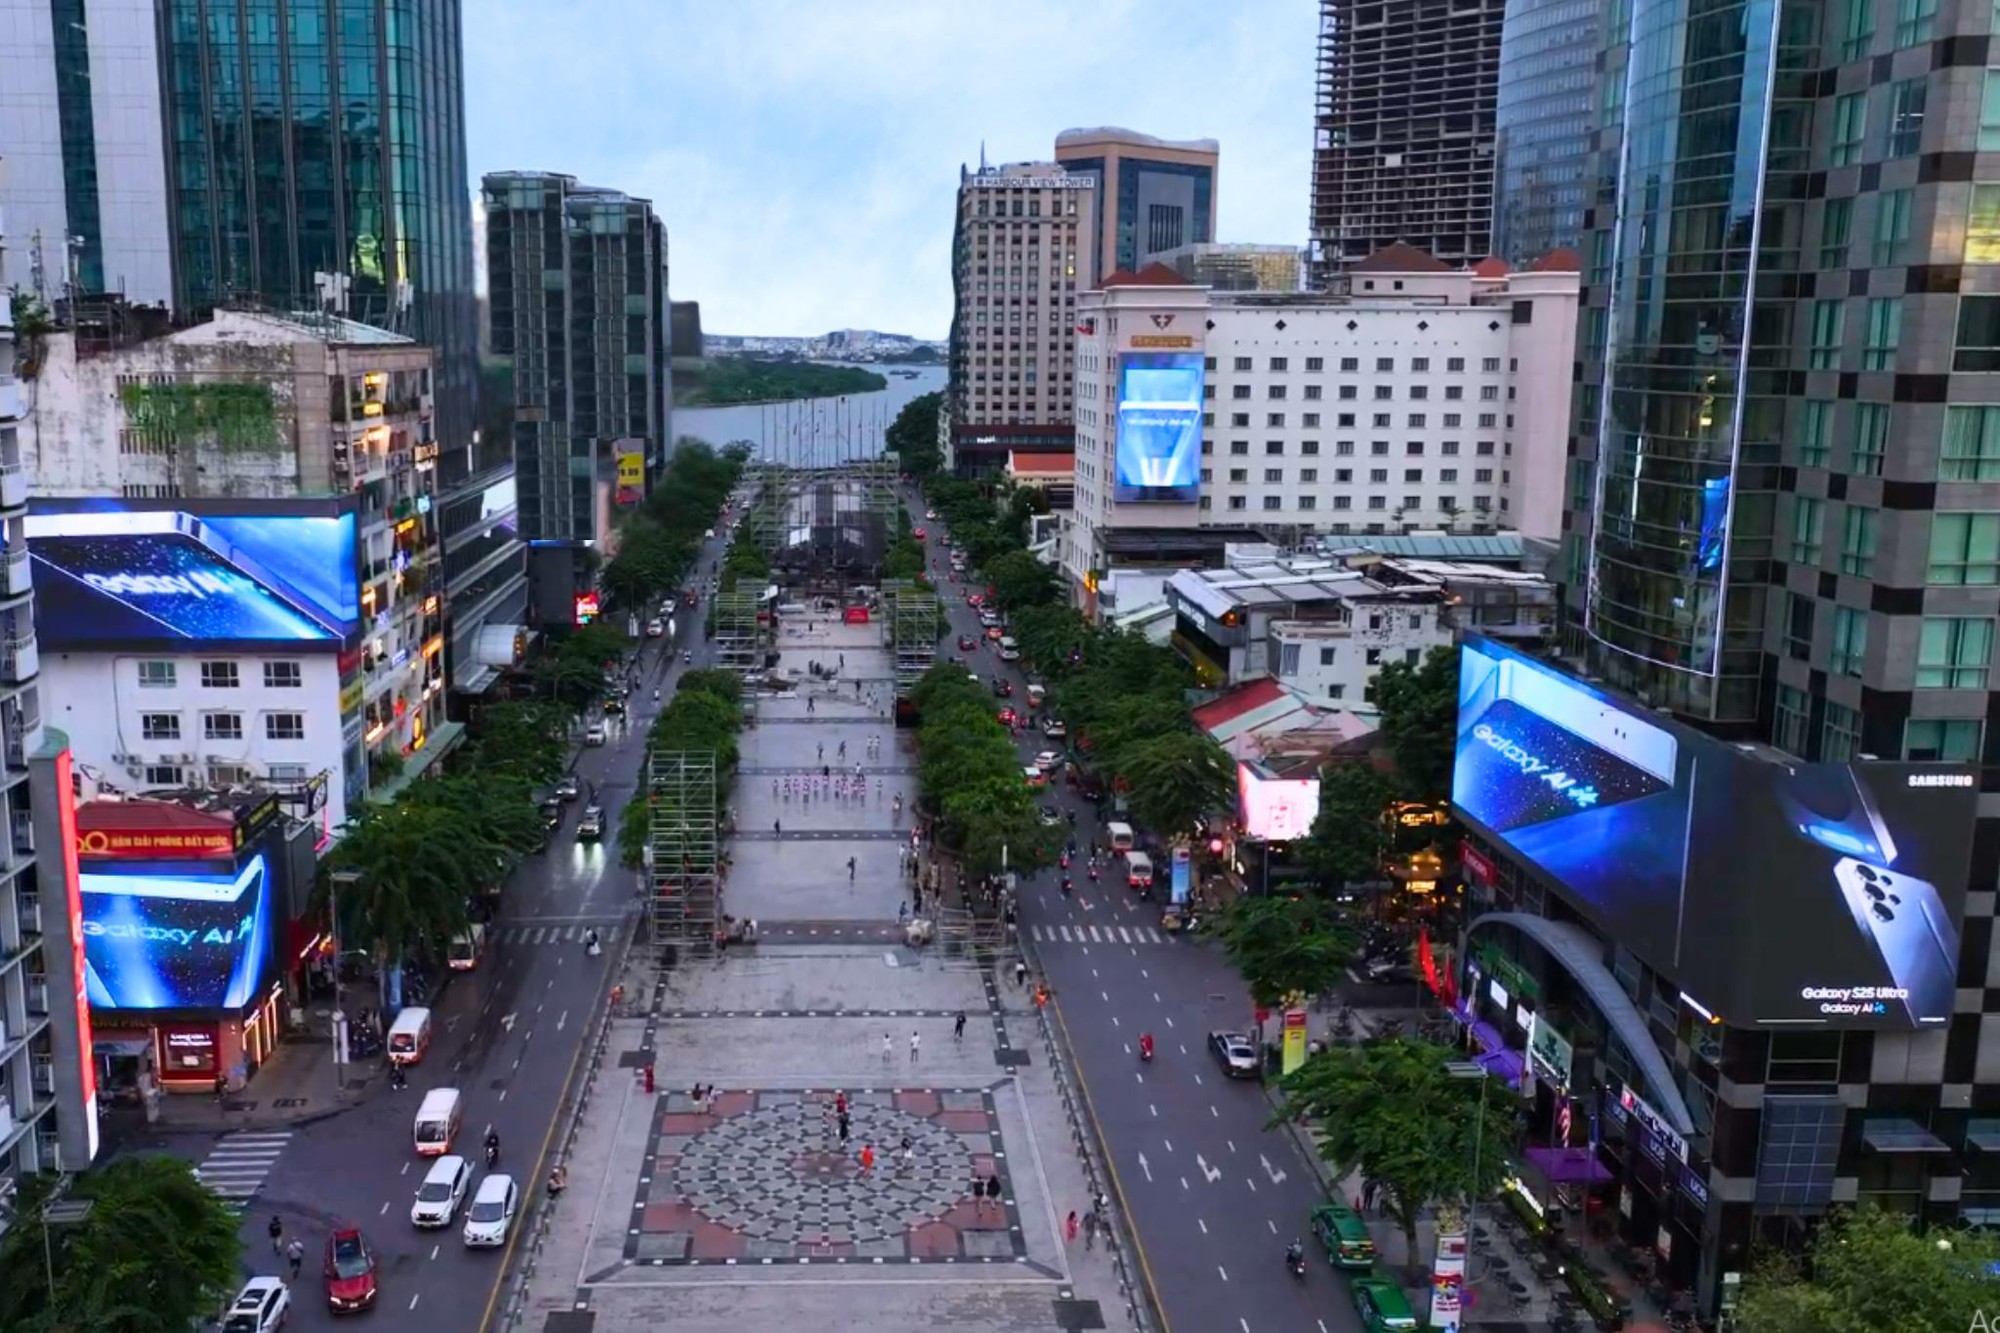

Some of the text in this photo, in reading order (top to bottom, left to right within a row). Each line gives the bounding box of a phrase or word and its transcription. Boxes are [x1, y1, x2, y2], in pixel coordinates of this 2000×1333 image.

[1031, 178, 1057, 188] VIEW
[1059, 178, 1092, 188] TOWER
[1473, 724, 1549, 774] Galaxy
[1908, 774, 1973, 787] SAMSUNG
[82, 920, 198, 945] Galaxy
[1802, 986, 1909, 1001] Galaxy S25 Ultra
[1820, 1002, 1874, 1015] Galaxy AI
